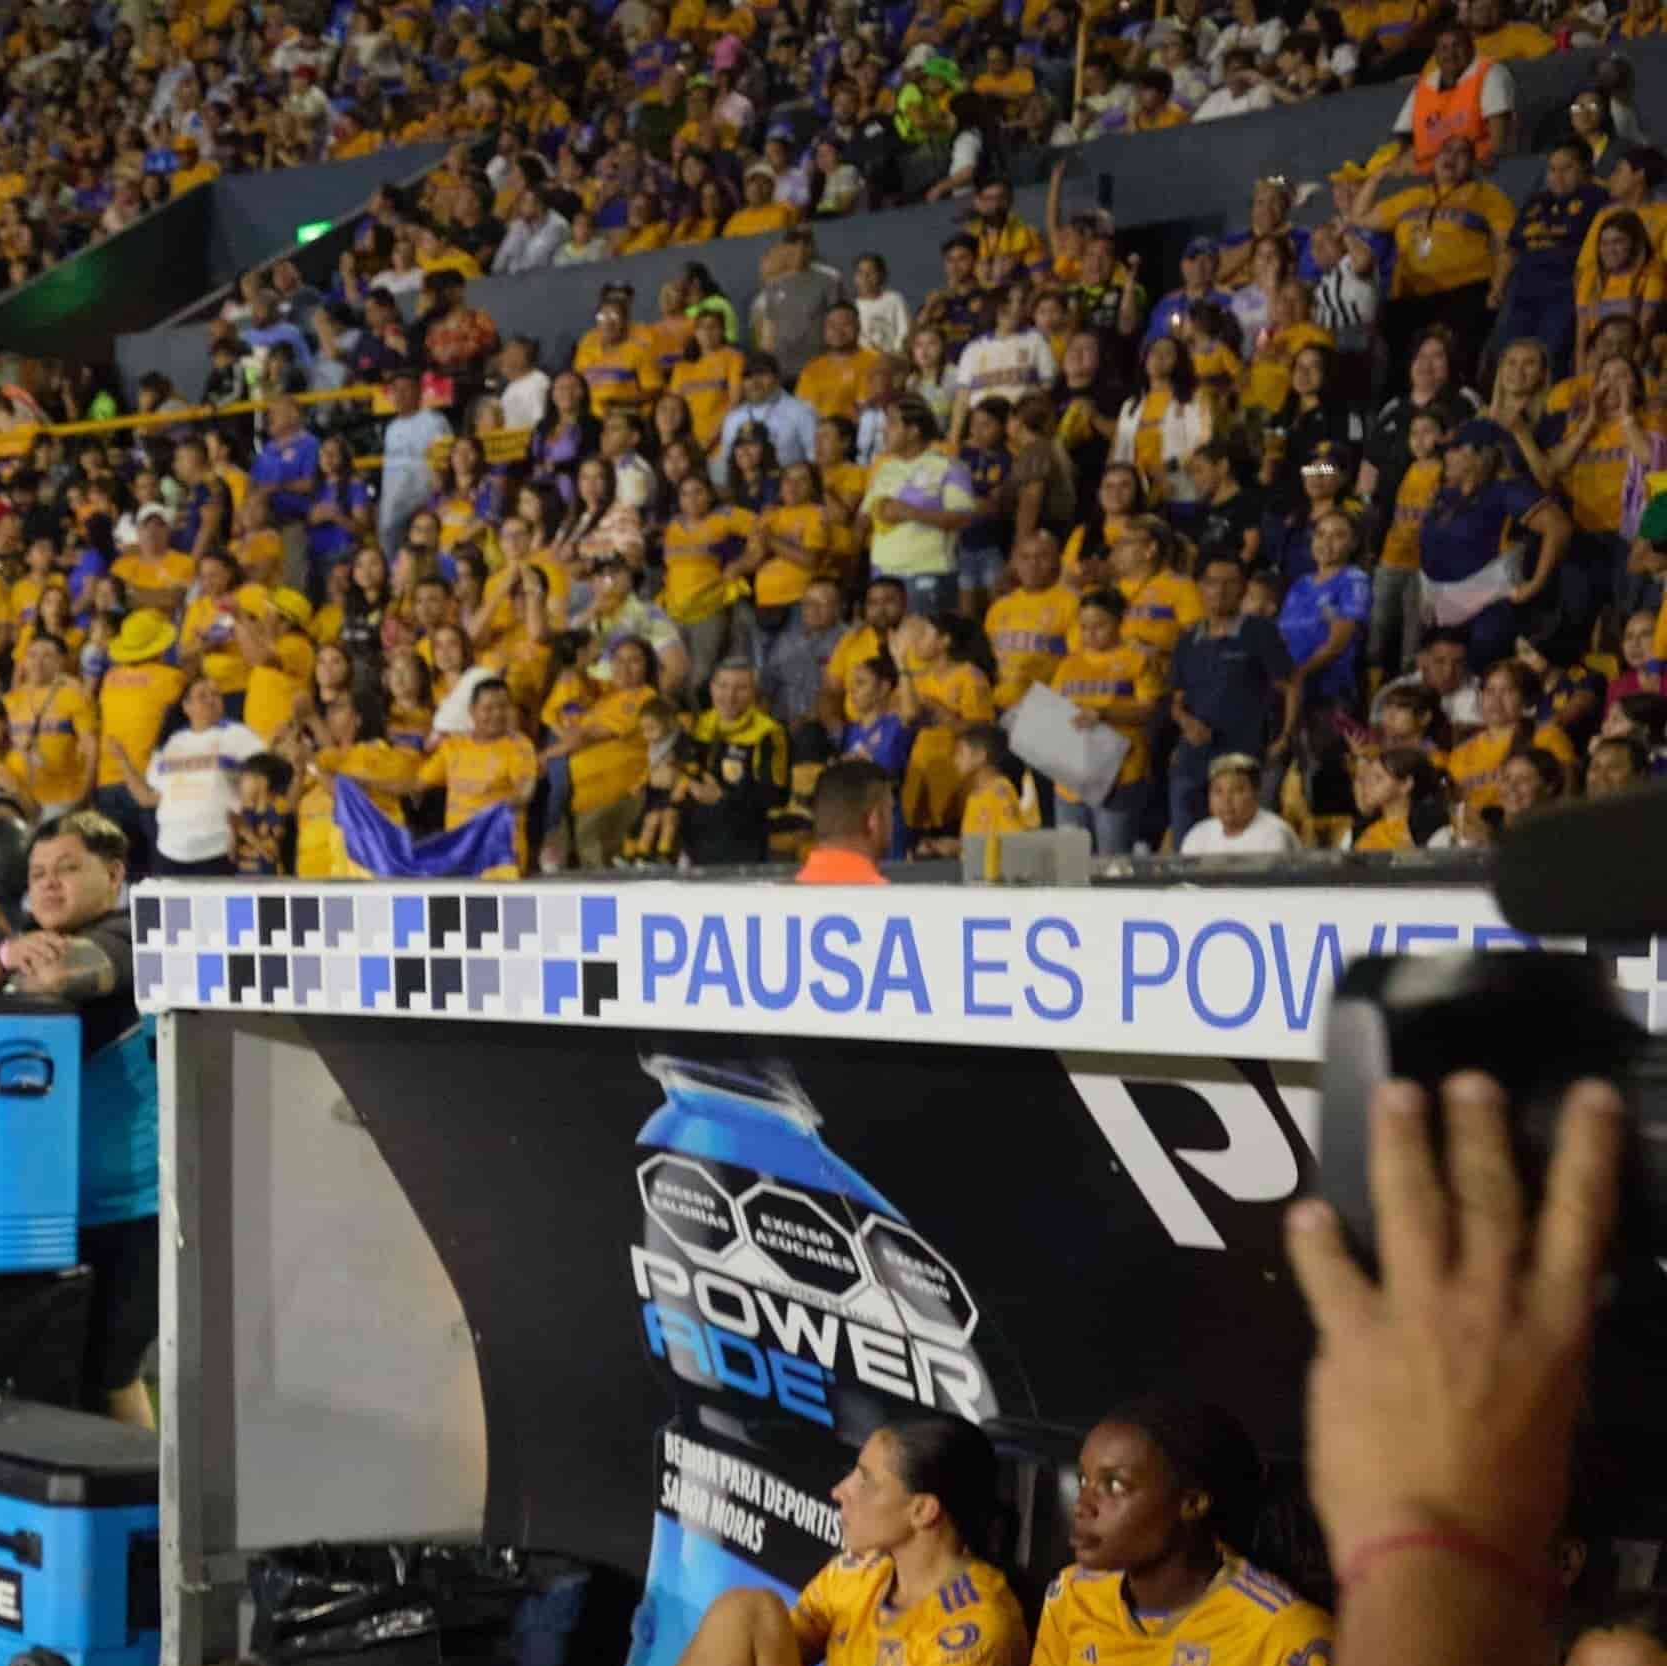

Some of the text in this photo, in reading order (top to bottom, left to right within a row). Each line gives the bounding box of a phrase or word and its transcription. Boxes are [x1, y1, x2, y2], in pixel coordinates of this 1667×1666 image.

[639, 911, 1540, 1032] PAUSA ES POW
[759, 1212, 834, 1249] EXCESO
[630, 1244, 982, 1427] POWER
[642, 1301, 835, 1429] ADE
[710, 1496, 766, 1555] MORAS
[719, 1454, 762, 1507] PARA
[763, 1475, 846, 1550] DEPORTIS
